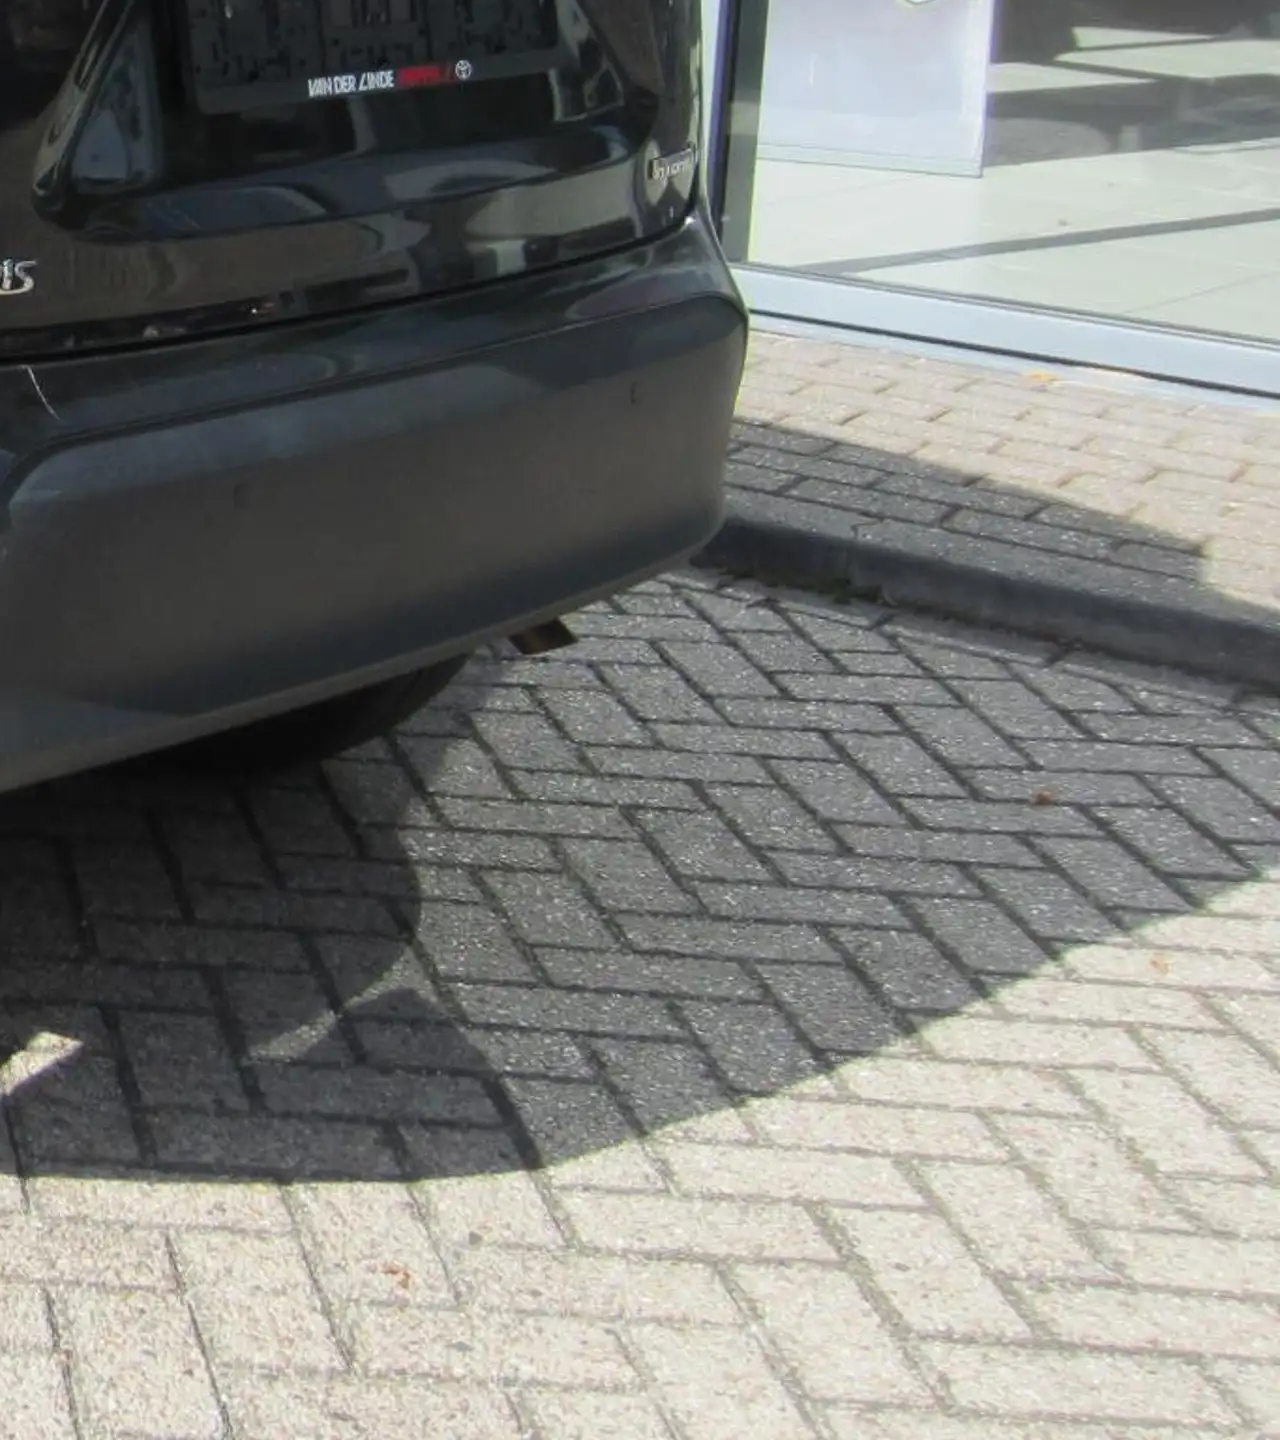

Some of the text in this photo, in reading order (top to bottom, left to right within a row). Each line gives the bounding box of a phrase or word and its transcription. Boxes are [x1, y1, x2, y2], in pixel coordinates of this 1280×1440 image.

[308, 78, 333, 98] VAN
[334, 73, 357, 94] DER
[359, 70, 395, 92] LINDE
